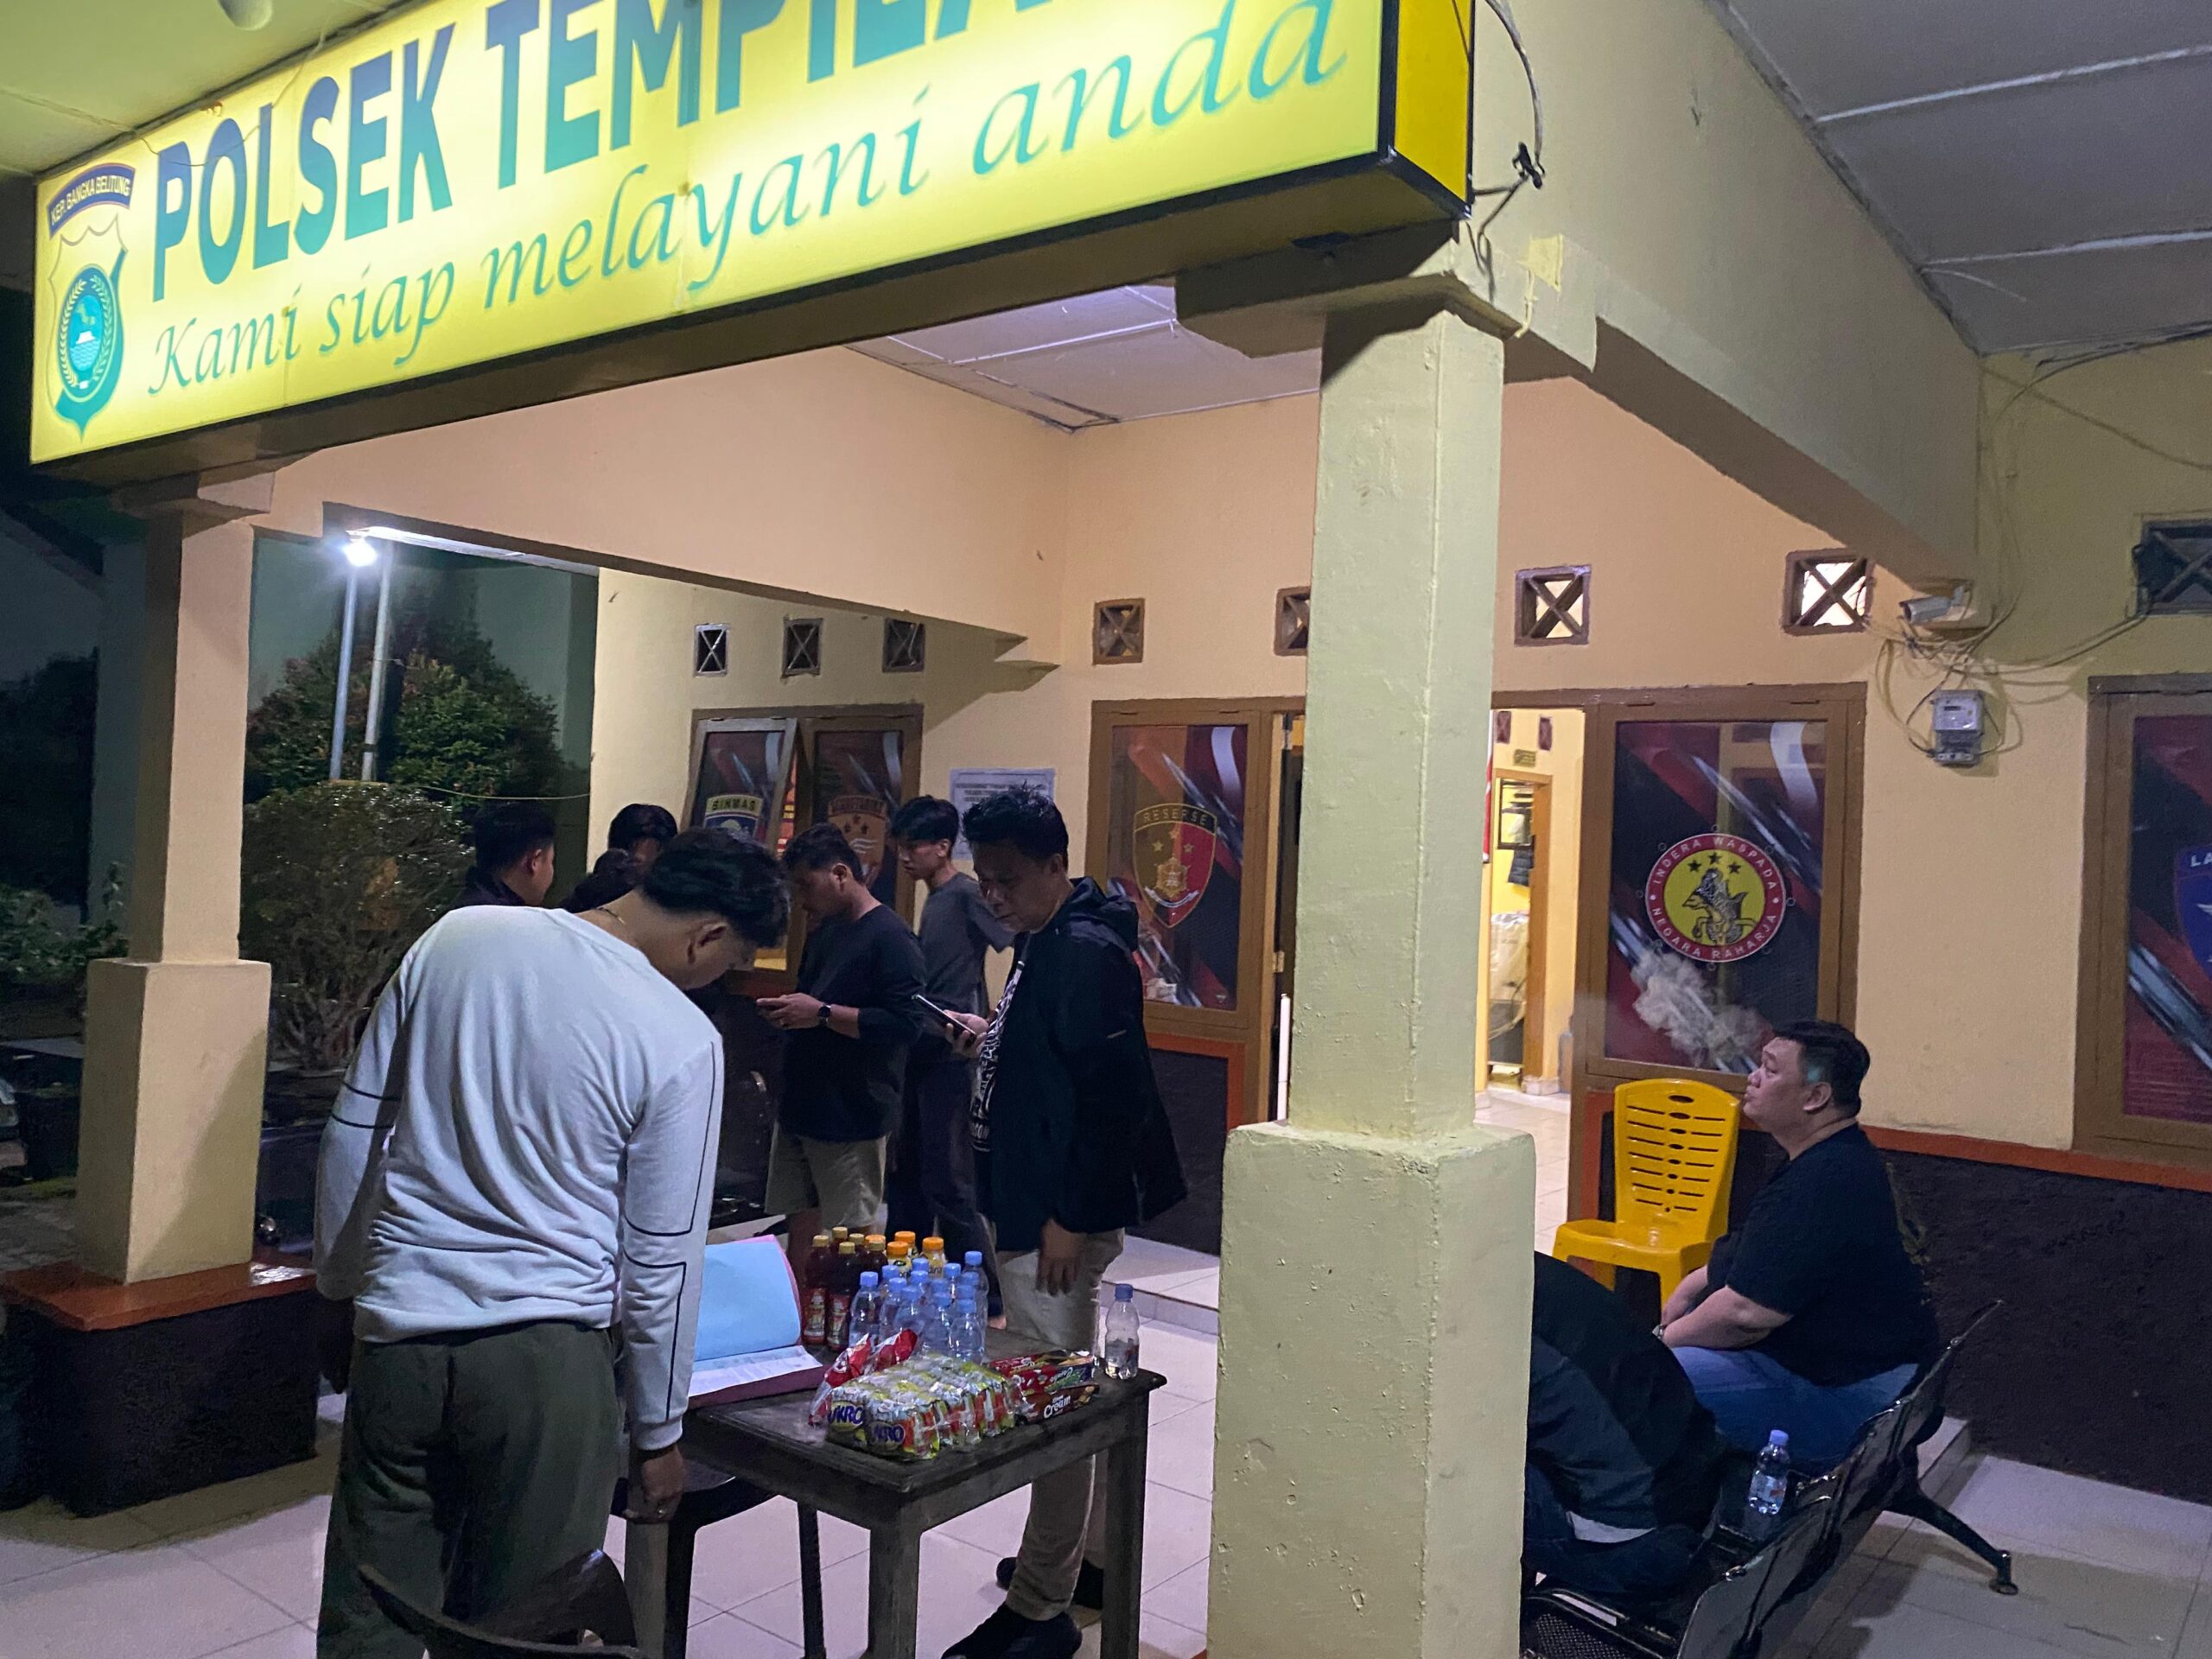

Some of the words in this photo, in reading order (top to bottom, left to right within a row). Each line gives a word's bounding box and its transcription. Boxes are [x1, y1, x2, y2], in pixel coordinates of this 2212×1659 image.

[152, 22, 455, 302] POLSEK
[66, 178, 95, 210] BANGKA
[148, 283, 302, 395] Kami
[319, 261, 455, 365] siap
[483, 84, 931, 308] melayani
[973, 0, 1347, 175] anda
[1142, 808, 1208, 825] RESERSE
[1653, 839, 1701, 885] INDERA
[1713, 836, 1777, 889] WASPADA
[1652, 907, 1701, 957] NEGARA
[1712, 914, 1777, 959] RAHARJA
